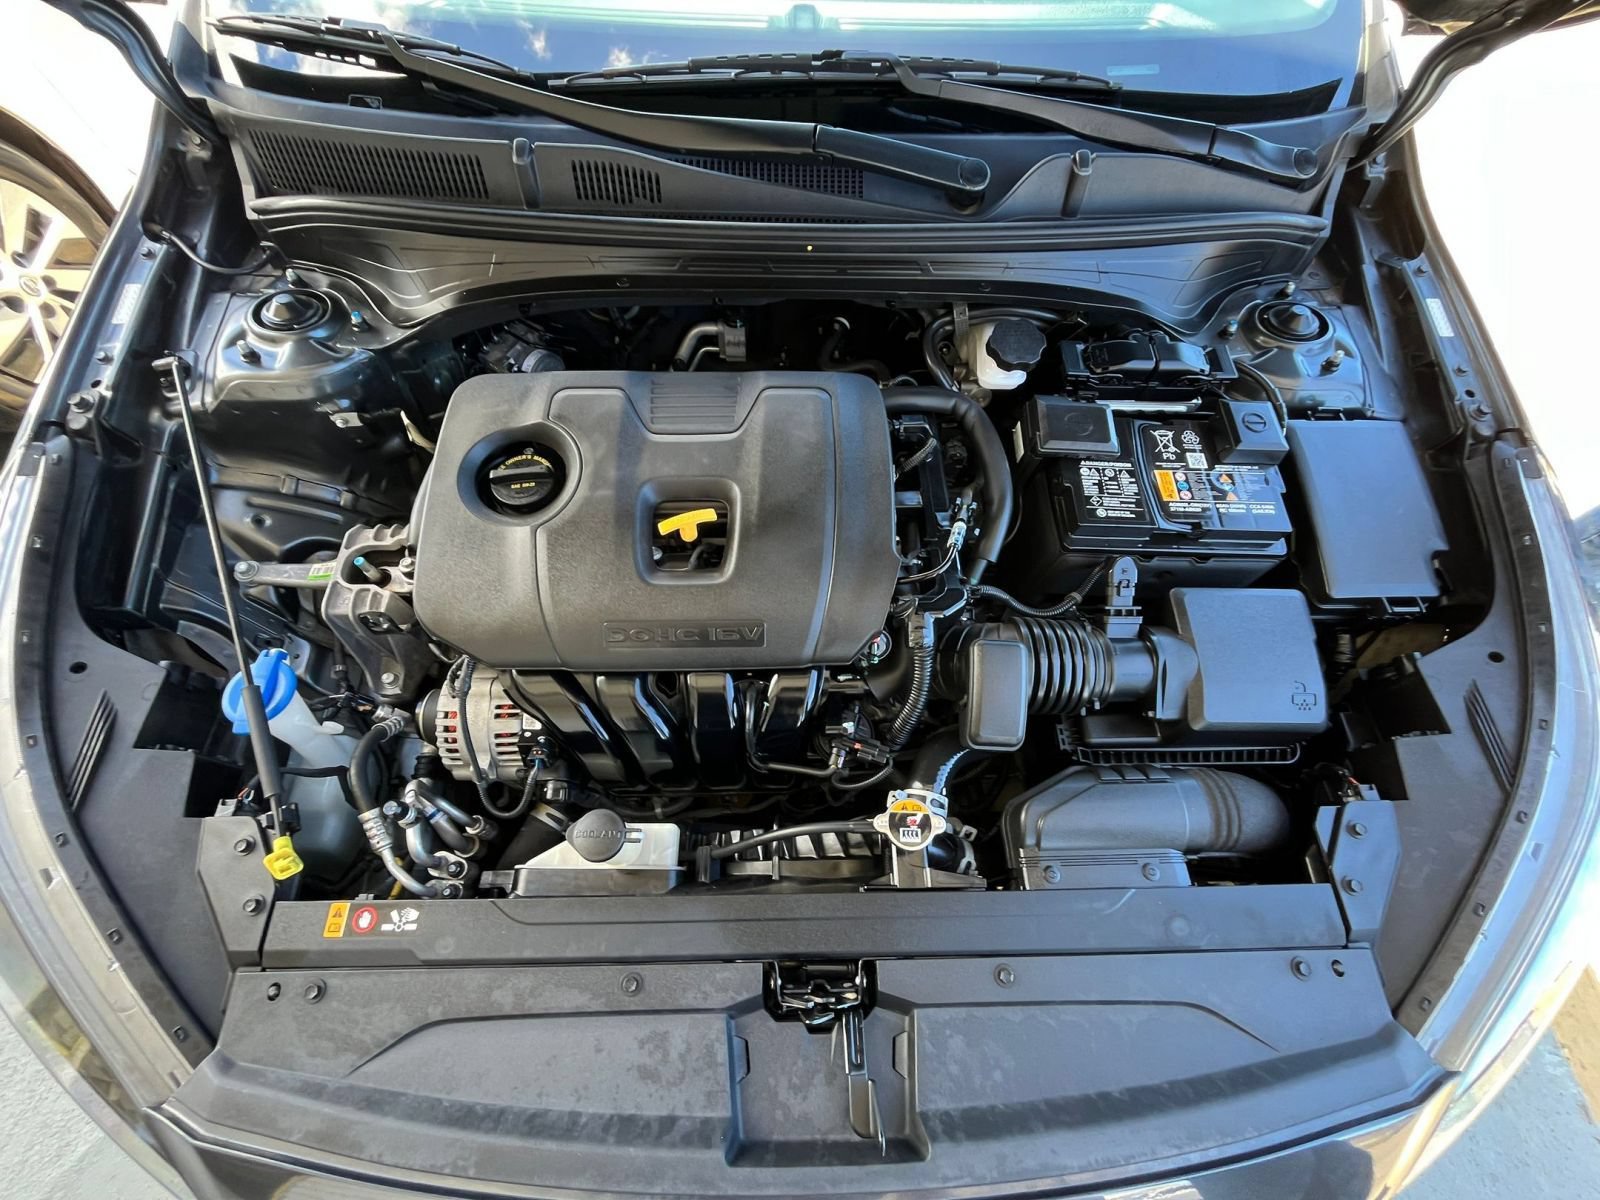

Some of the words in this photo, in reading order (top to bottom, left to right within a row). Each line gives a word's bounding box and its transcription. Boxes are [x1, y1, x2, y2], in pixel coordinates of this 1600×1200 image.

[1163, 452, 1177, 461] Pb
[607, 627, 700, 643] DOHC
[708, 626, 764, 642] 16V
[575, 830, 622, 839] COOLANT
